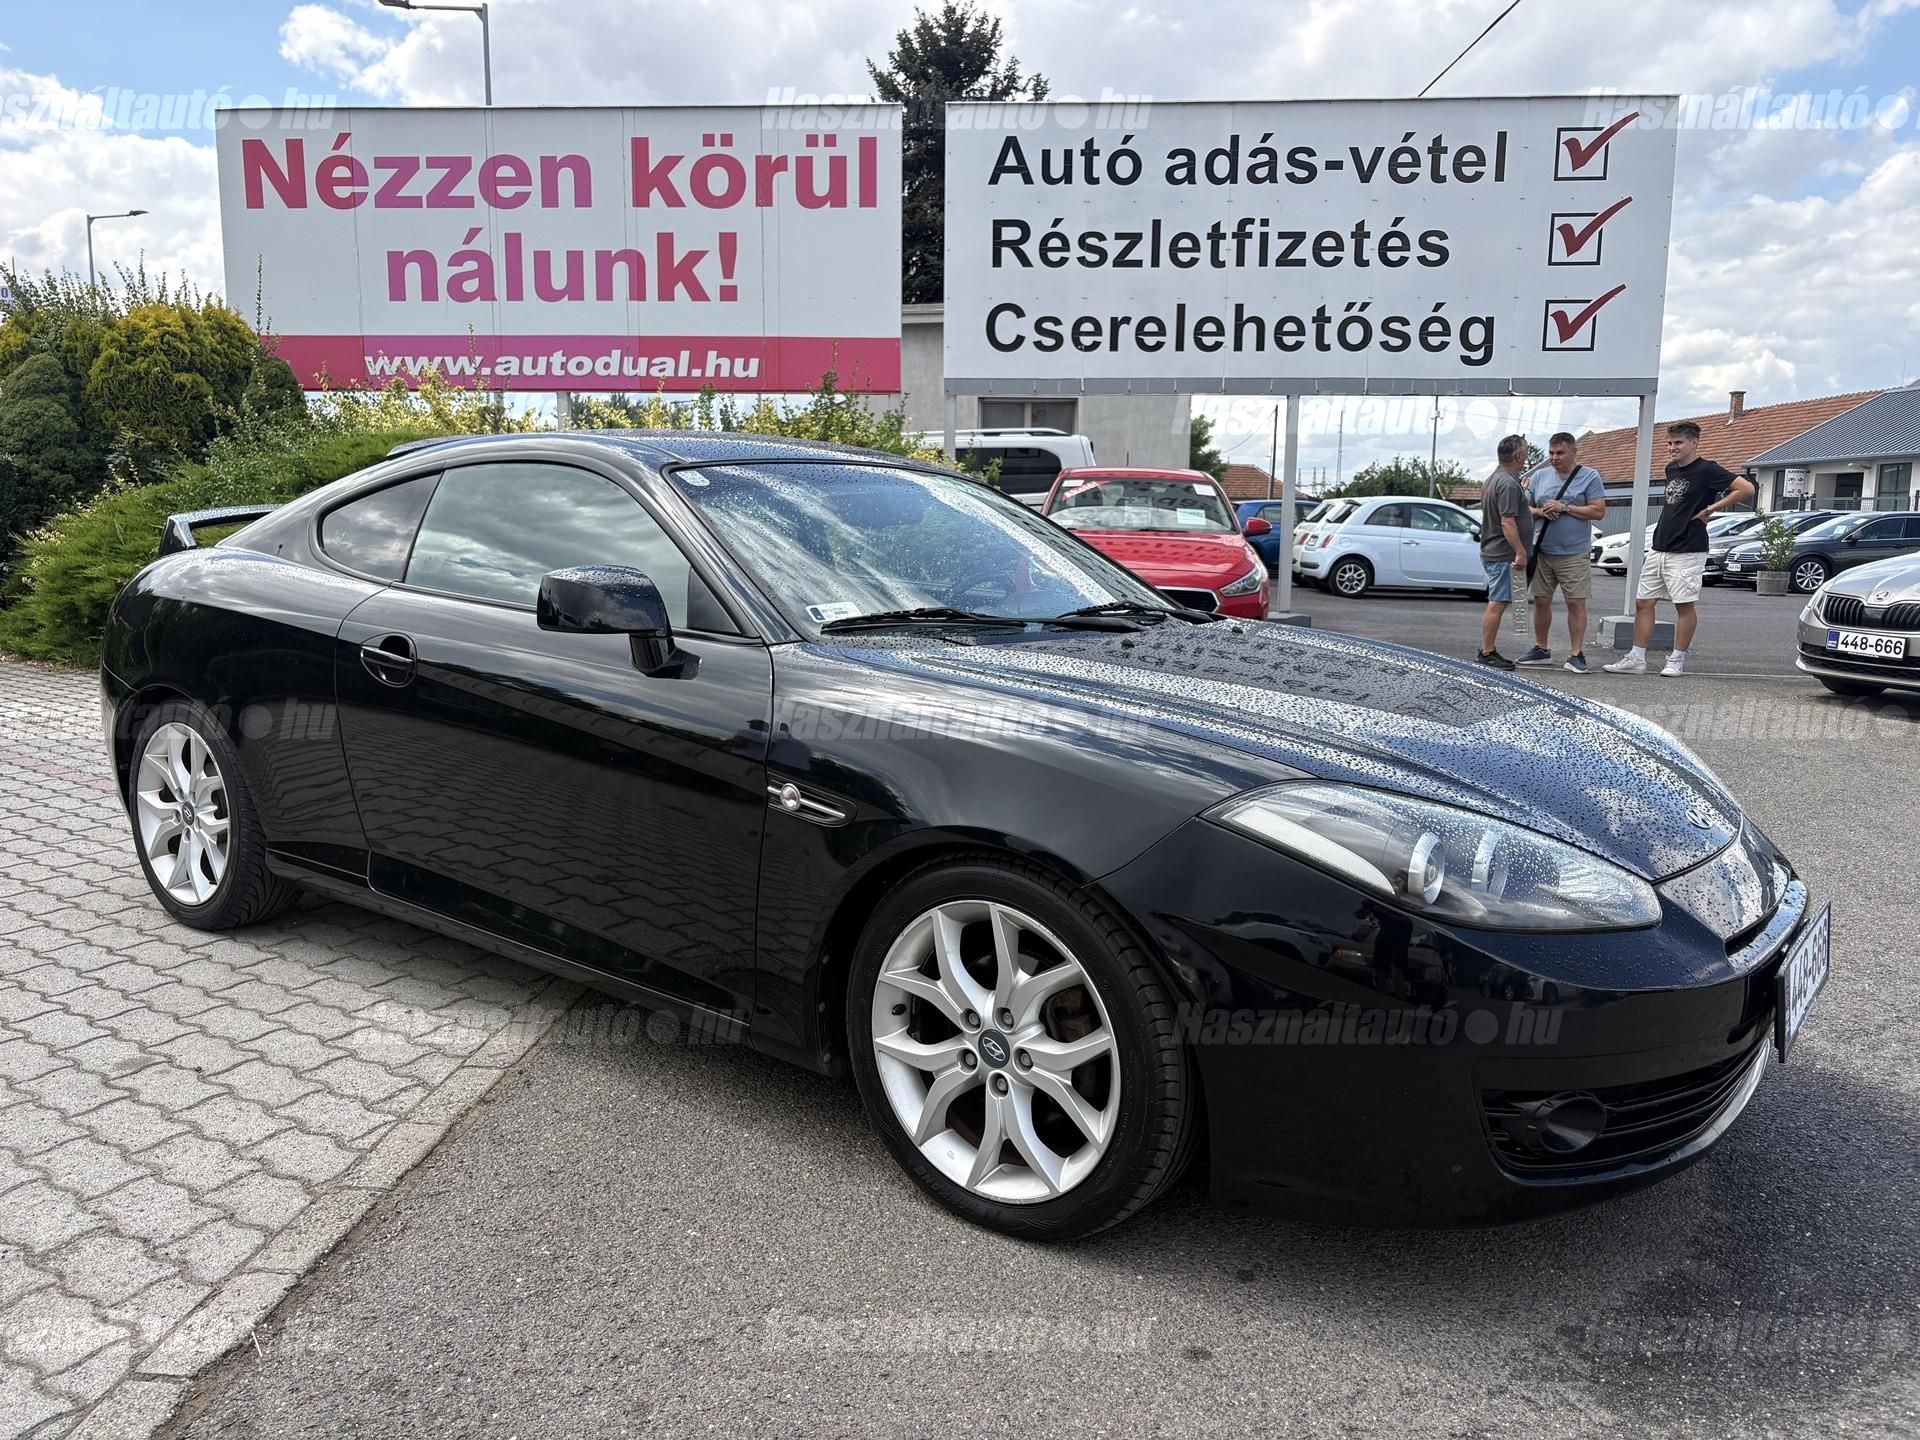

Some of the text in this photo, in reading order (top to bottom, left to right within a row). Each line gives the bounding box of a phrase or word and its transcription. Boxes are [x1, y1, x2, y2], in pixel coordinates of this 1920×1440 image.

[243, 132, 877, 209] Nézzen körül
[988, 131, 1508, 186] Autó adás-vétel
[388, 229, 739, 302] nálunk!
[992, 216, 1450, 269] Részletfizetés
[985, 301, 1495, 367] Cserelehetőség
[364, 349, 760, 379] www.autodual.hu
[1840, 633, 1903, 656] 448-666
